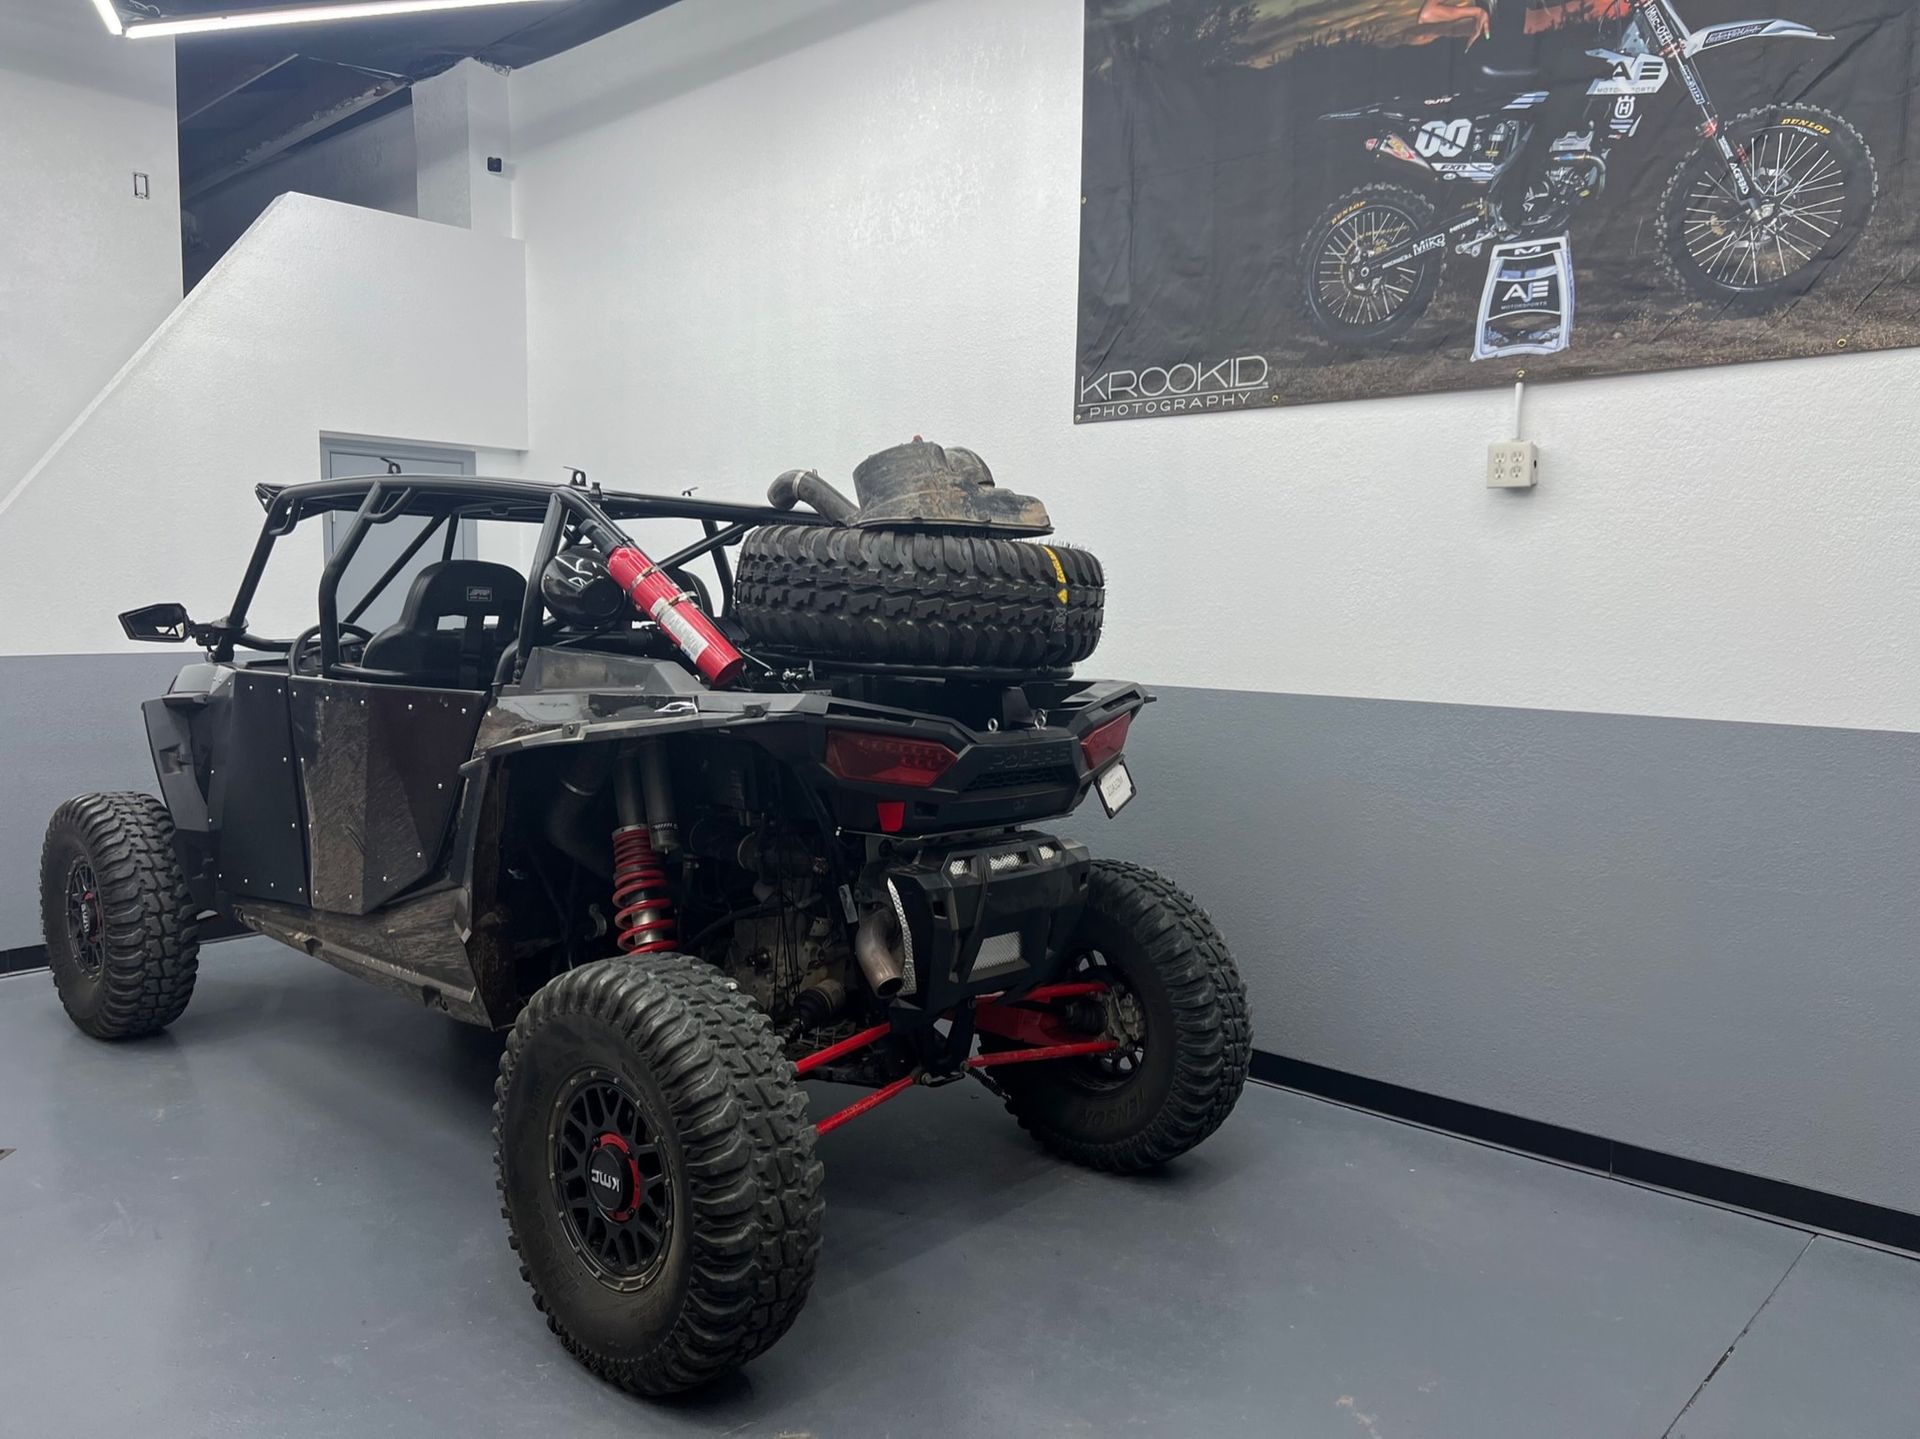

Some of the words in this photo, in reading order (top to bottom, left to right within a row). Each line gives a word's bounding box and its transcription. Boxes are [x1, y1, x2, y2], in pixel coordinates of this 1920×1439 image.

[1647, 5, 1672, 44] Muc-Off
[1781, 117, 1831, 135] DUNLOP
[1080, 355, 1268, 403] KROOKID
[1089, 392, 1251, 418] PHOTOGRAPHY
[591, 1169, 620, 1192] KMC
